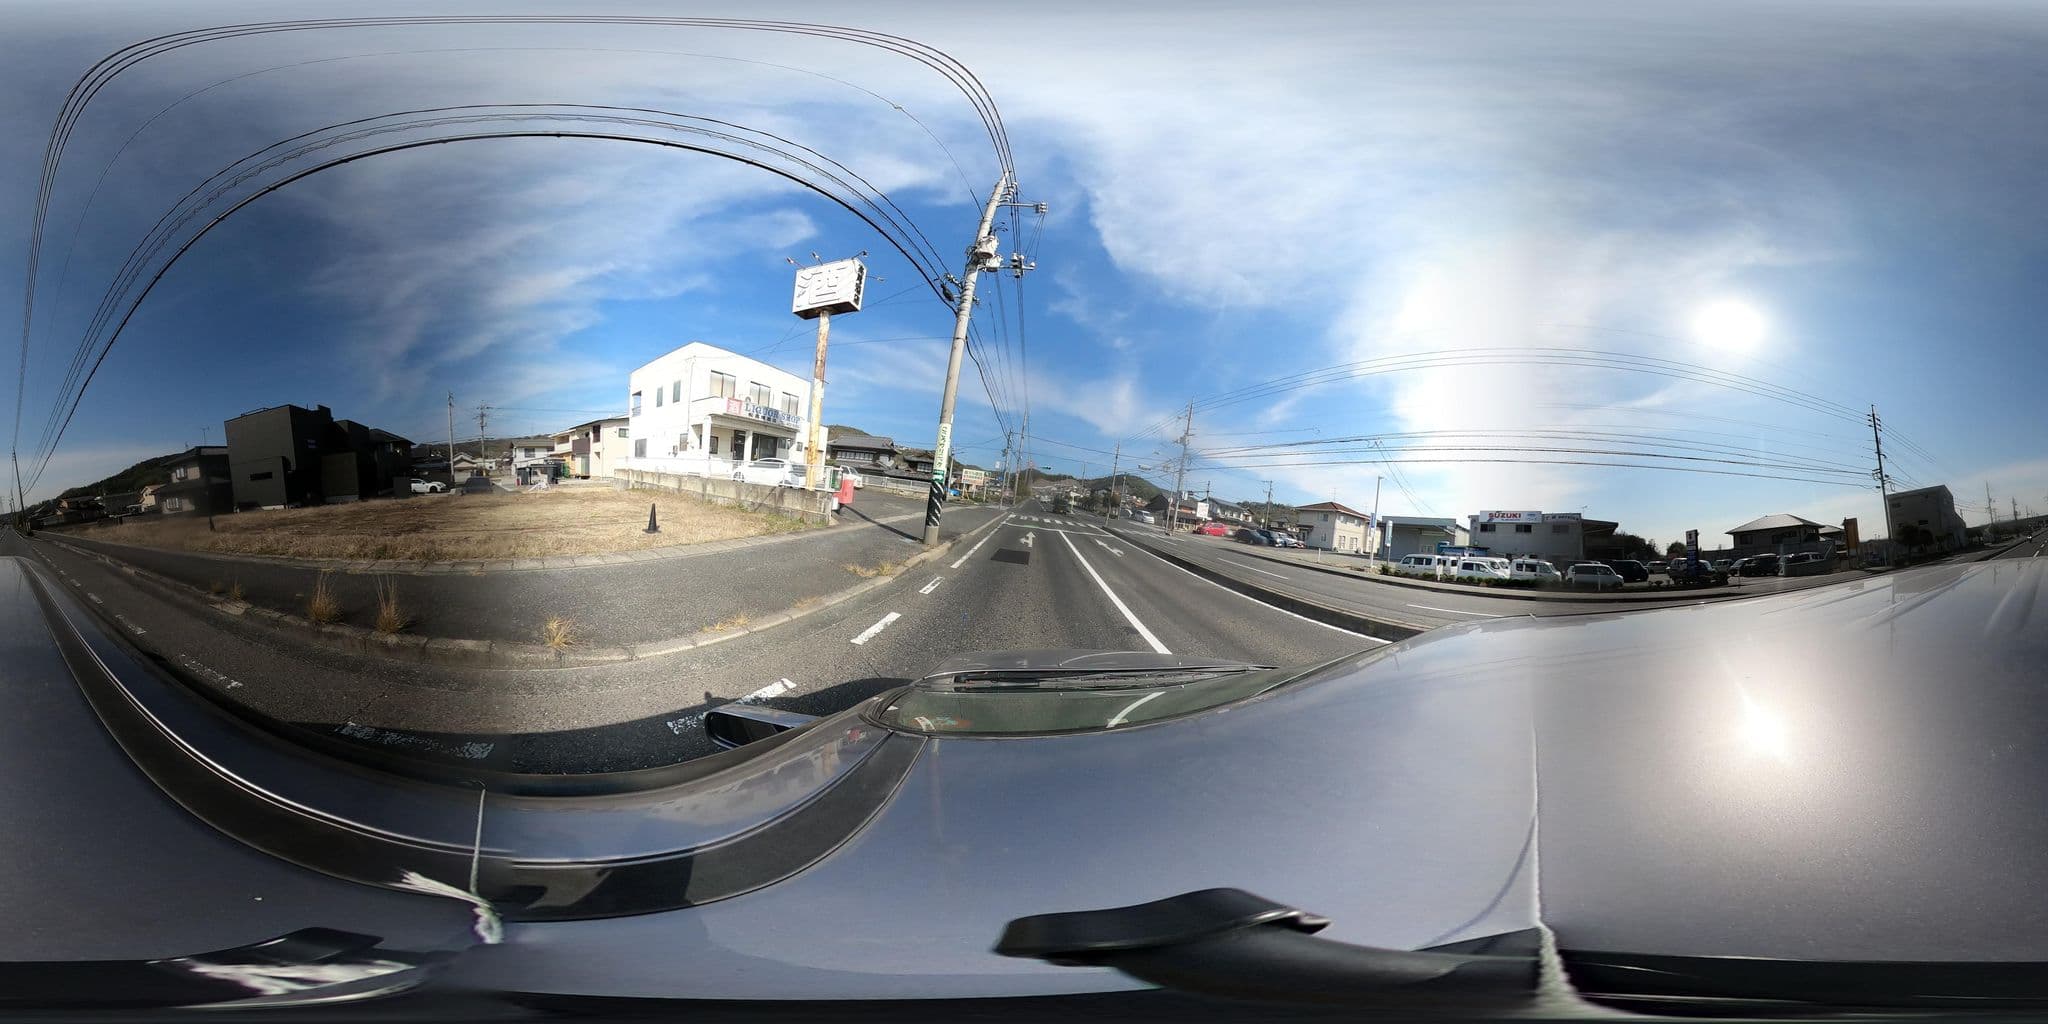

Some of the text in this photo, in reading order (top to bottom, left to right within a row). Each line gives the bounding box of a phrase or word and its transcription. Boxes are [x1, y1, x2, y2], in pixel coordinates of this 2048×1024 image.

[796, 266, 848, 308] 酒
[745, 403, 779, 418] LIQUOR
[781, 413, 801, 424] SHOP
